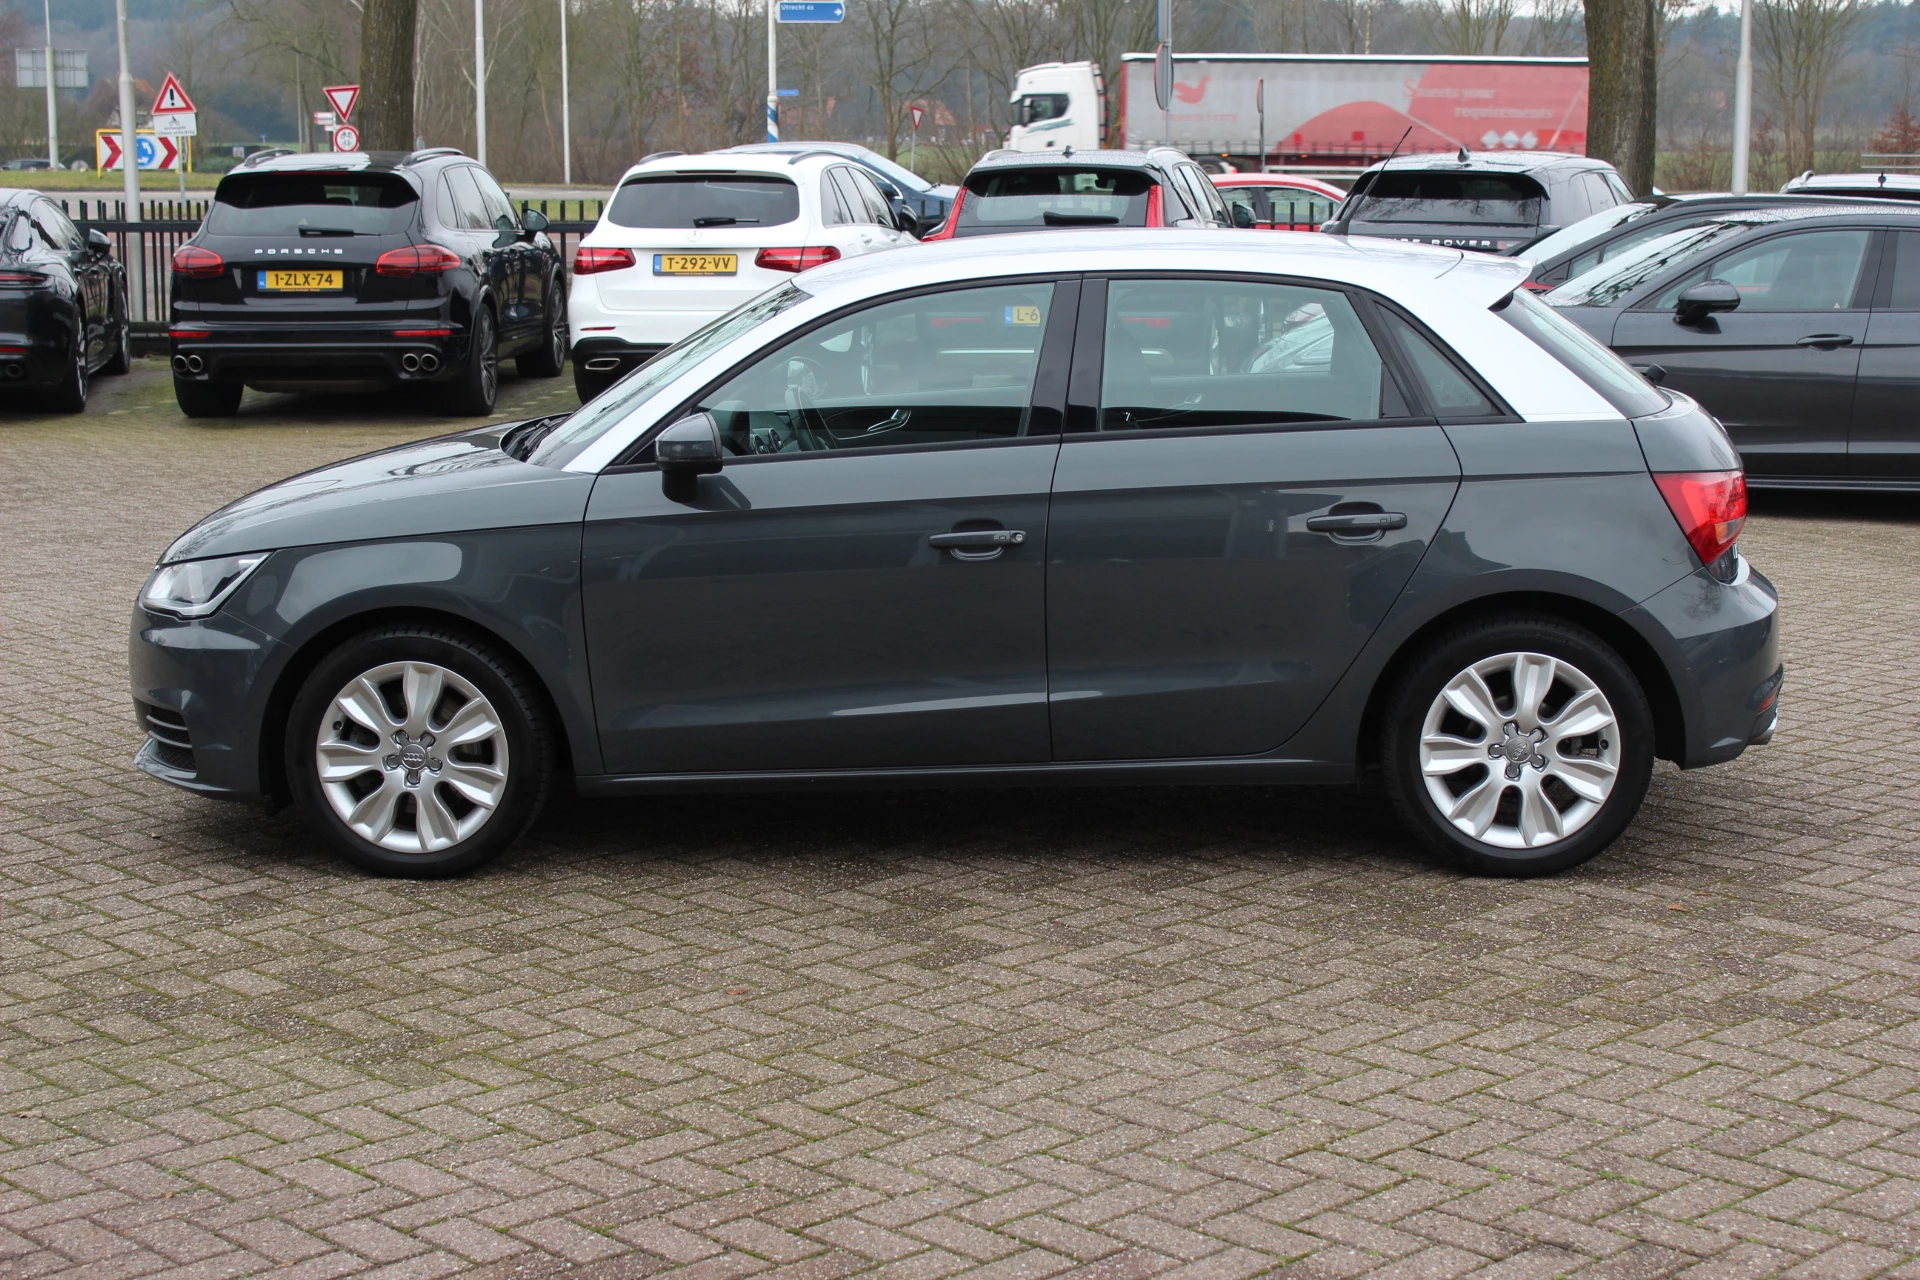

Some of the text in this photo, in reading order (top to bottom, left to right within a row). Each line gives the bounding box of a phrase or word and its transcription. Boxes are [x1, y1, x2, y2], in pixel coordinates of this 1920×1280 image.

[1431, 239, 1491, 248] ROVER
[667, 257, 731, 270] T-292-VV
[274, 273, 334, 286] 1-ZLX-74
